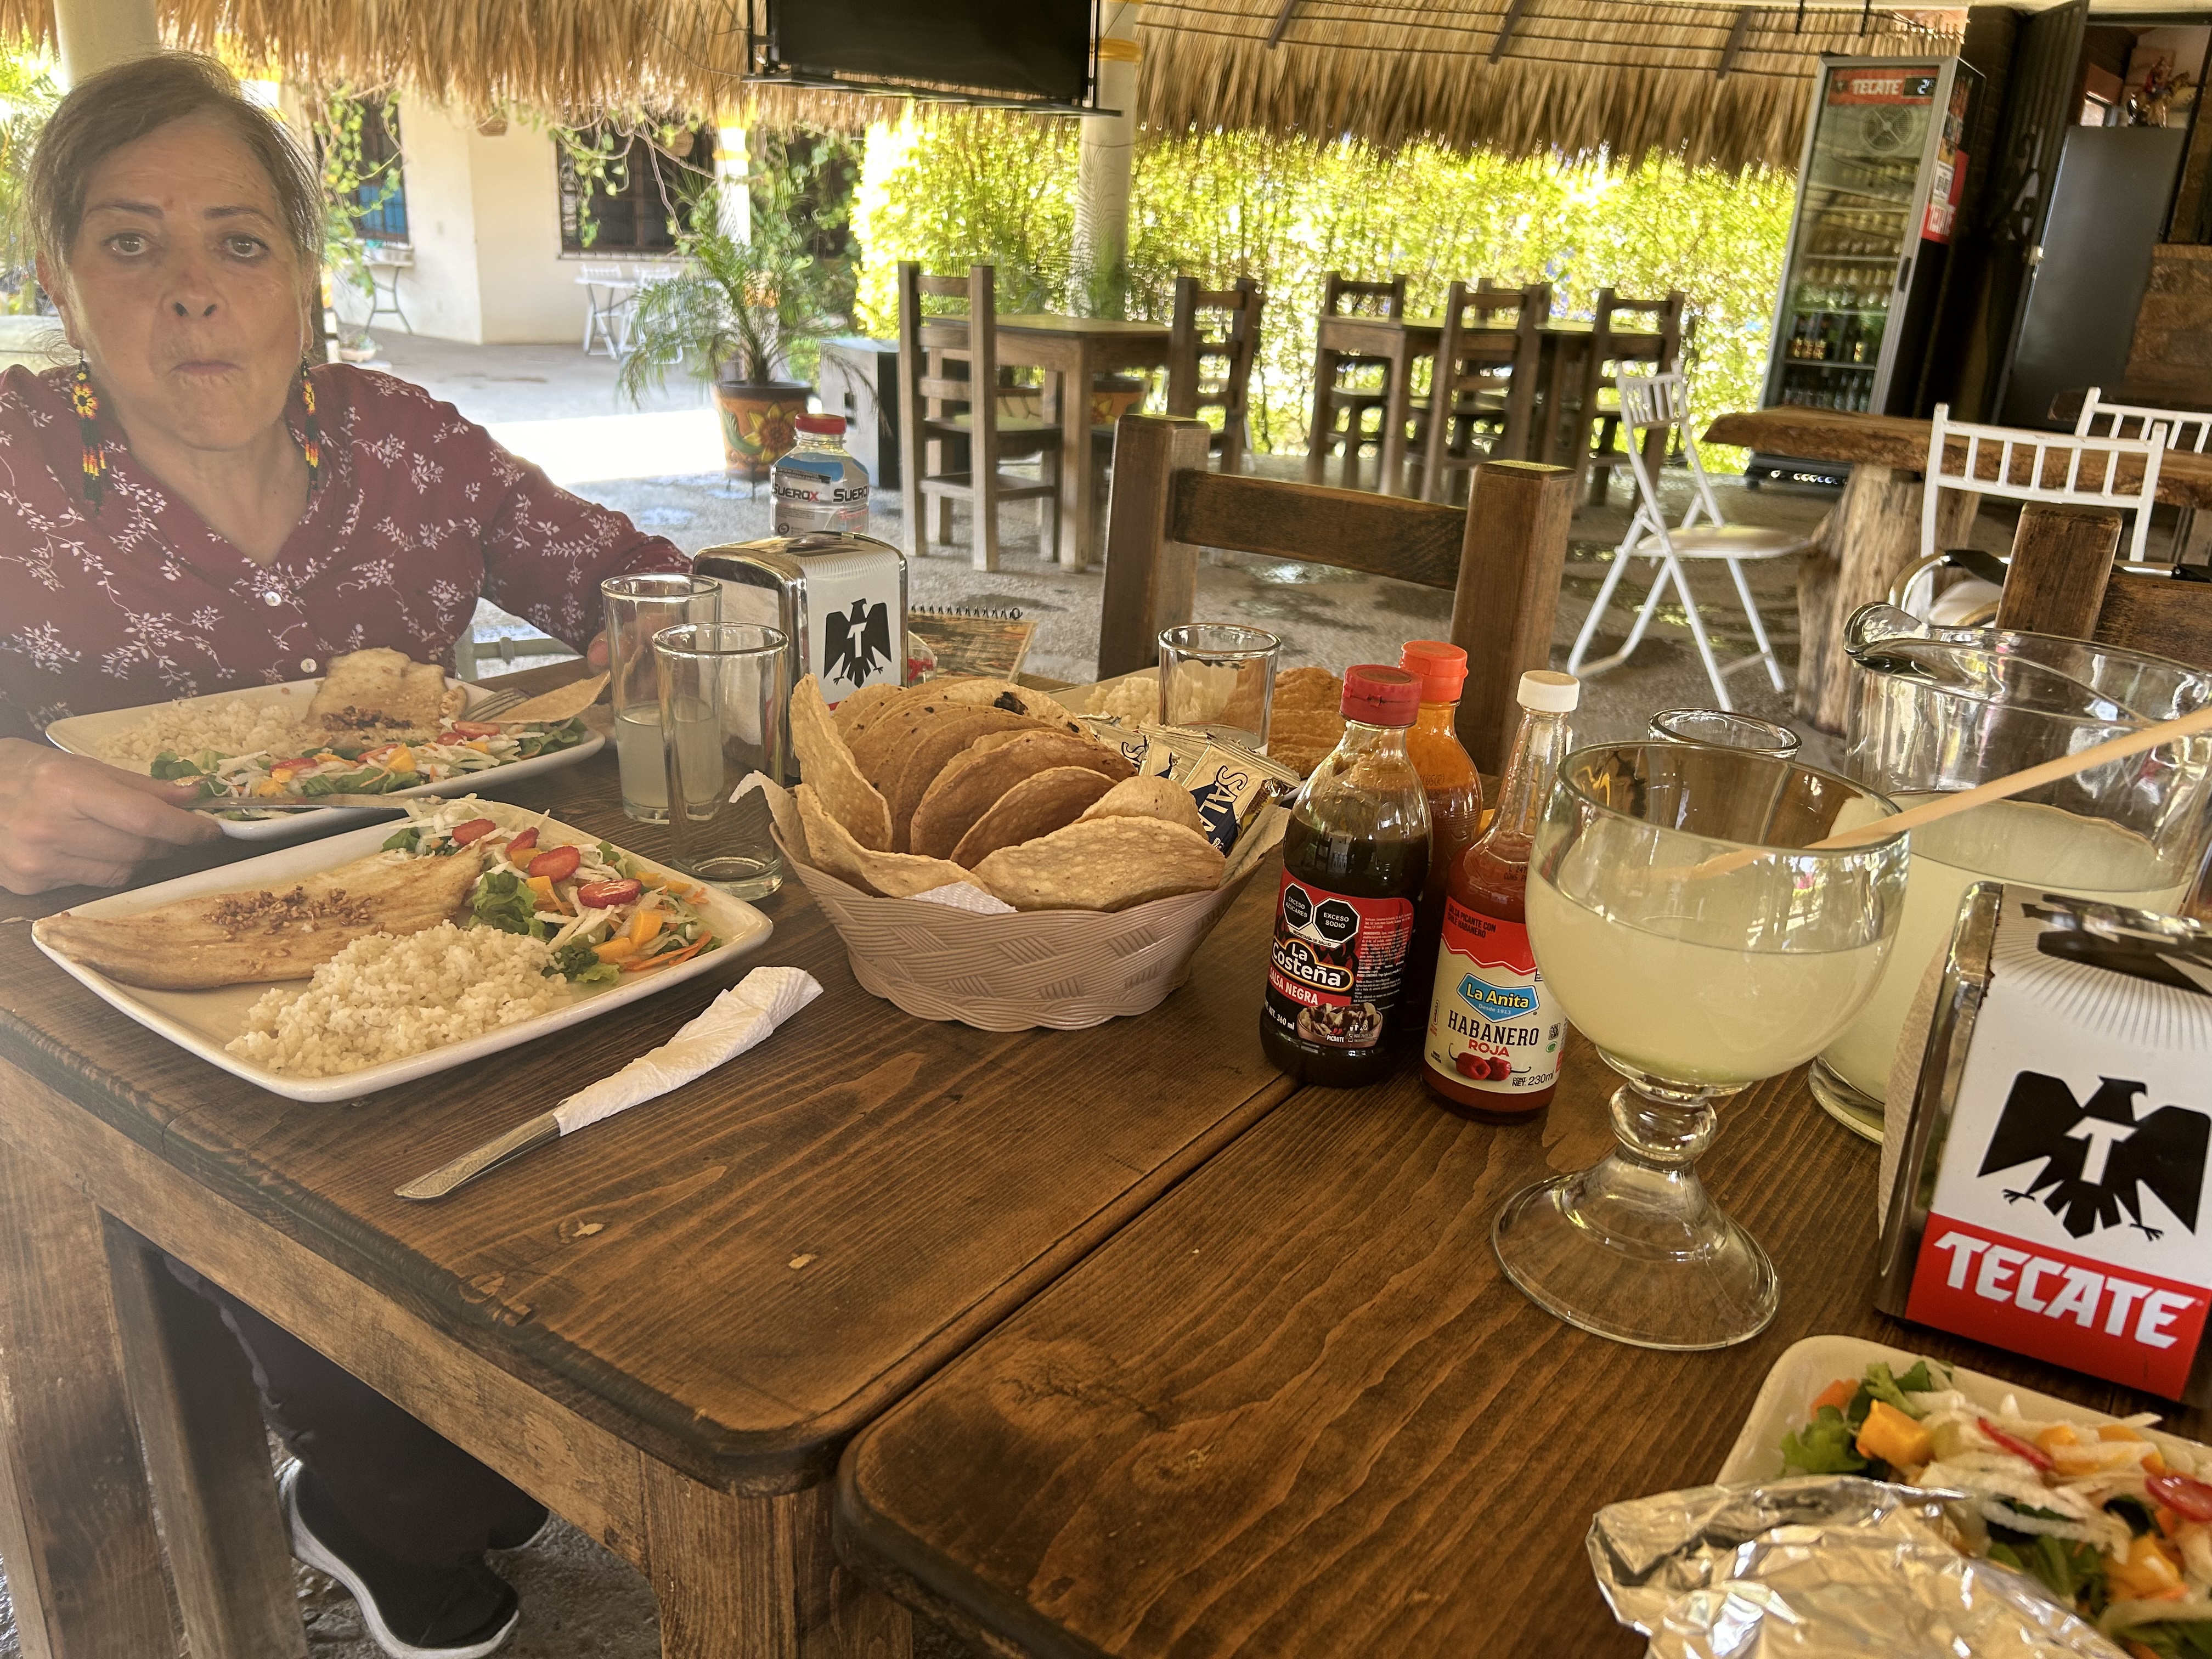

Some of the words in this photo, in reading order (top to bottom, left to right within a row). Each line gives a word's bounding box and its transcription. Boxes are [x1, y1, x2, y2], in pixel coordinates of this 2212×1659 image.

[1852, 78, 1903, 95] TECATE
[833, 484, 870, 504] SUERO
[847, 622, 866, 658] T
[1285, 901, 1307, 918] AZÚCARES
[1288, 896, 1305, 910] EXCESO
[1323, 912, 1350, 922] EXCESO
[1325, 919, 1346, 929] SODIO
[1447, 911, 1458, 926] CHILE
[1458, 919, 1486, 938] HABANERO
[1449, 903, 1460, 918] SALSA
[1460, 912, 1483, 928] PICANTE
[1483, 922, 1497, 933] CON
[1291, 943, 1308, 961] La
[1273, 942, 1341, 987] Costeña
[1269, 966, 1284, 990] SALSA
[1285, 984, 1318, 1006] NEGRA
[1466, 983, 1483, 1001] La
[1485, 990, 1530, 1008] Anita
[1479, 1003, 1496, 1012] Desde
[1277, 1013, 1286, 1025] 360
[1287, 1022, 1295, 1030] ml
[1447, 1009, 1539, 1046] HABANERO
[1327, 1034, 1345, 1043] PICANTE
[1468, 1039, 1510, 1057] ROJA
[1528, 1070, 1554, 1086] 230ml
[2064, 1116, 2140, 1187] T
[1934, 1231, 2196, 1350] TECATE
